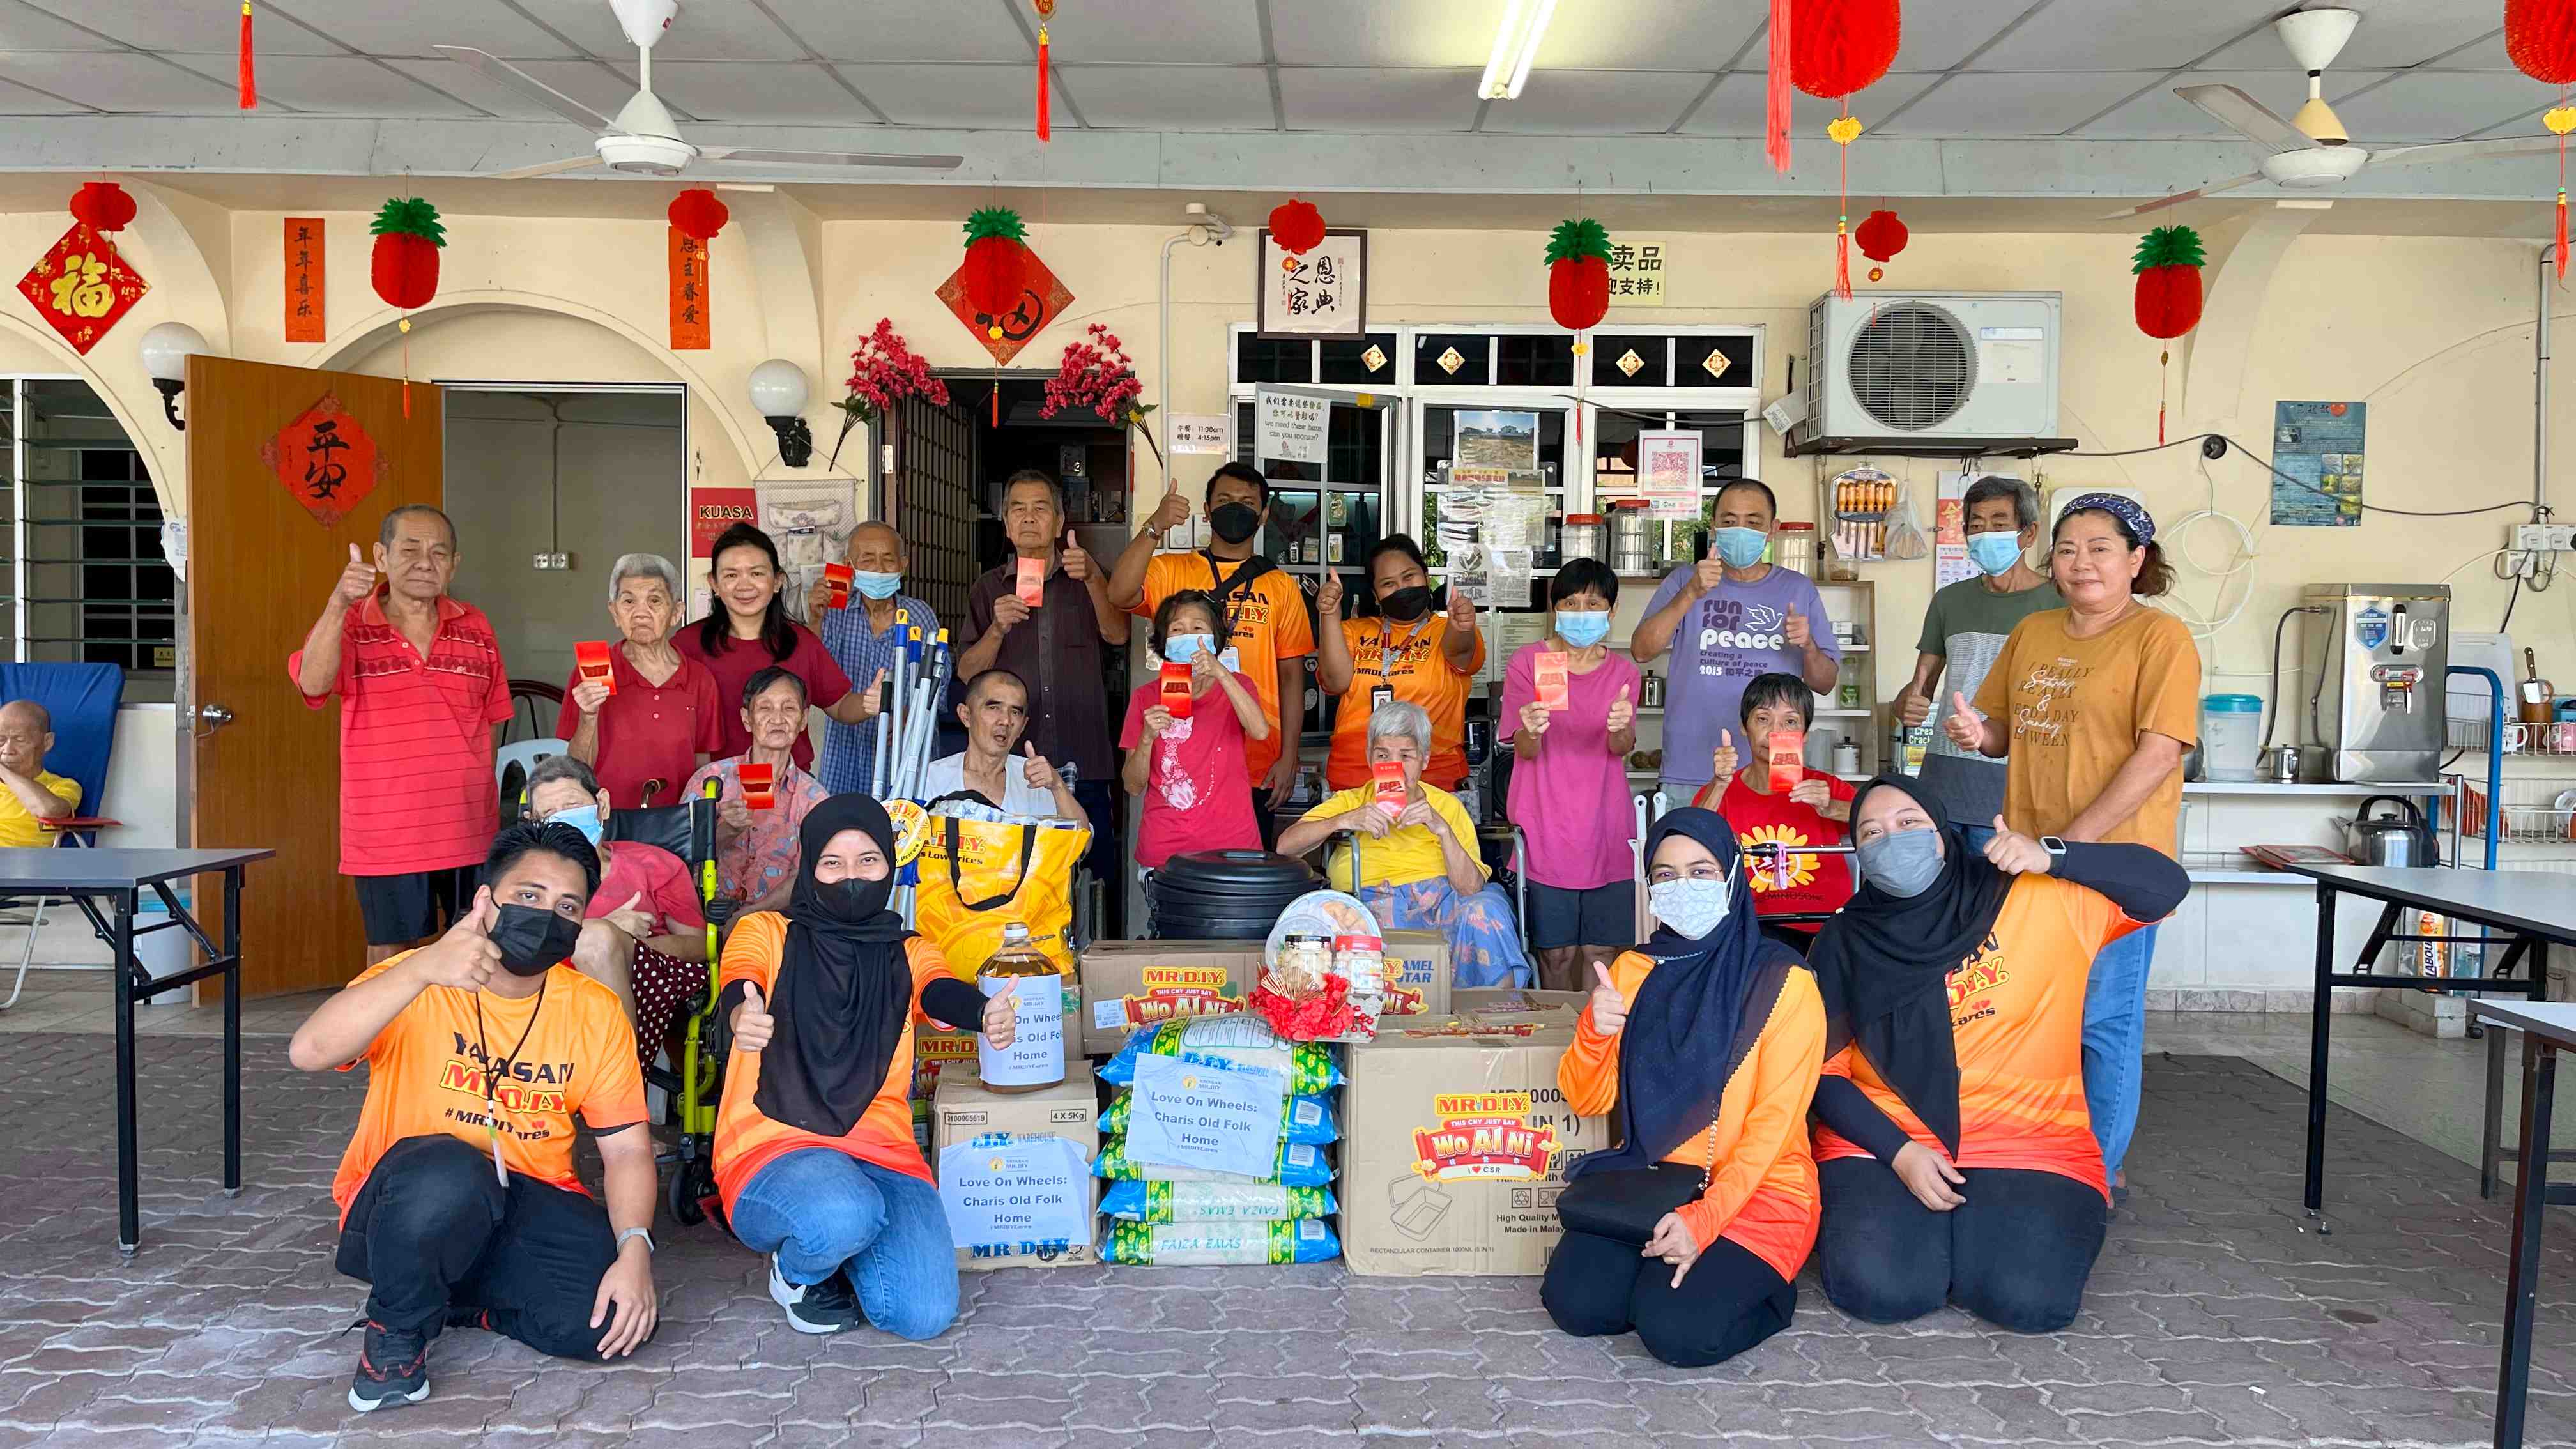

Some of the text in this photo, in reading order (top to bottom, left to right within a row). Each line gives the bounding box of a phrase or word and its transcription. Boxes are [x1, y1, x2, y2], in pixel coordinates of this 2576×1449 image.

[1612, 245, 1662, 271] 卖品
[50, 252, 115, 318] 福
[1198, 425, 1223, 434] 11:00am
[305, 420, 351, 500] 平安
[699, 505, 754, 520] KUASA
[1704, 599, 1743, 615] run
[1702, 614, 1741, 631] for
[1699, 629, 1784, 651] peace
[1699, 650, 1735, 660] creating
[1699, 657, 1730, 666] culture
[1743, 660, 1768, 668] peace
[1699, 666, 1722, 676] 2015
[2053, 710, 2080, 723] DAY
[1915, 727, 1933, 735] Crea
[2425, 940, 2437, 977] LABOU
[1402, 960, 1434, 971] AMEL
[1139, 1000, 1171, 1019] Wo
[1015, 1012, 1062, 1024] On Whee
[1027, 1032, 1046, 1042] Old
[1013, 1050, 1048, 1061] Home
[1151, 1091, 1257, 1112] Love On Wheels:
[1068, 1112, 1085, 1121] 5Kg
[1154, 1112, 1252, 1132] Charis Old Folk
[1182, 1133, 1220, 1146] Home
[1432, 1133, 1469, 1158] Wo
[1506, 1132, 1535, 1156] Ni
[959, 1175, 1068, 1187] Love On Wheels:
[1541, 1173, 1558, 1181] ith
[963, 1194, 1062, 1206] Charis Old Folk
[994, 1213, 1032, 1223] Home
[1496, 1214, 1516, 1223] High
[1519, 1213, 1549, 1222] Quality
